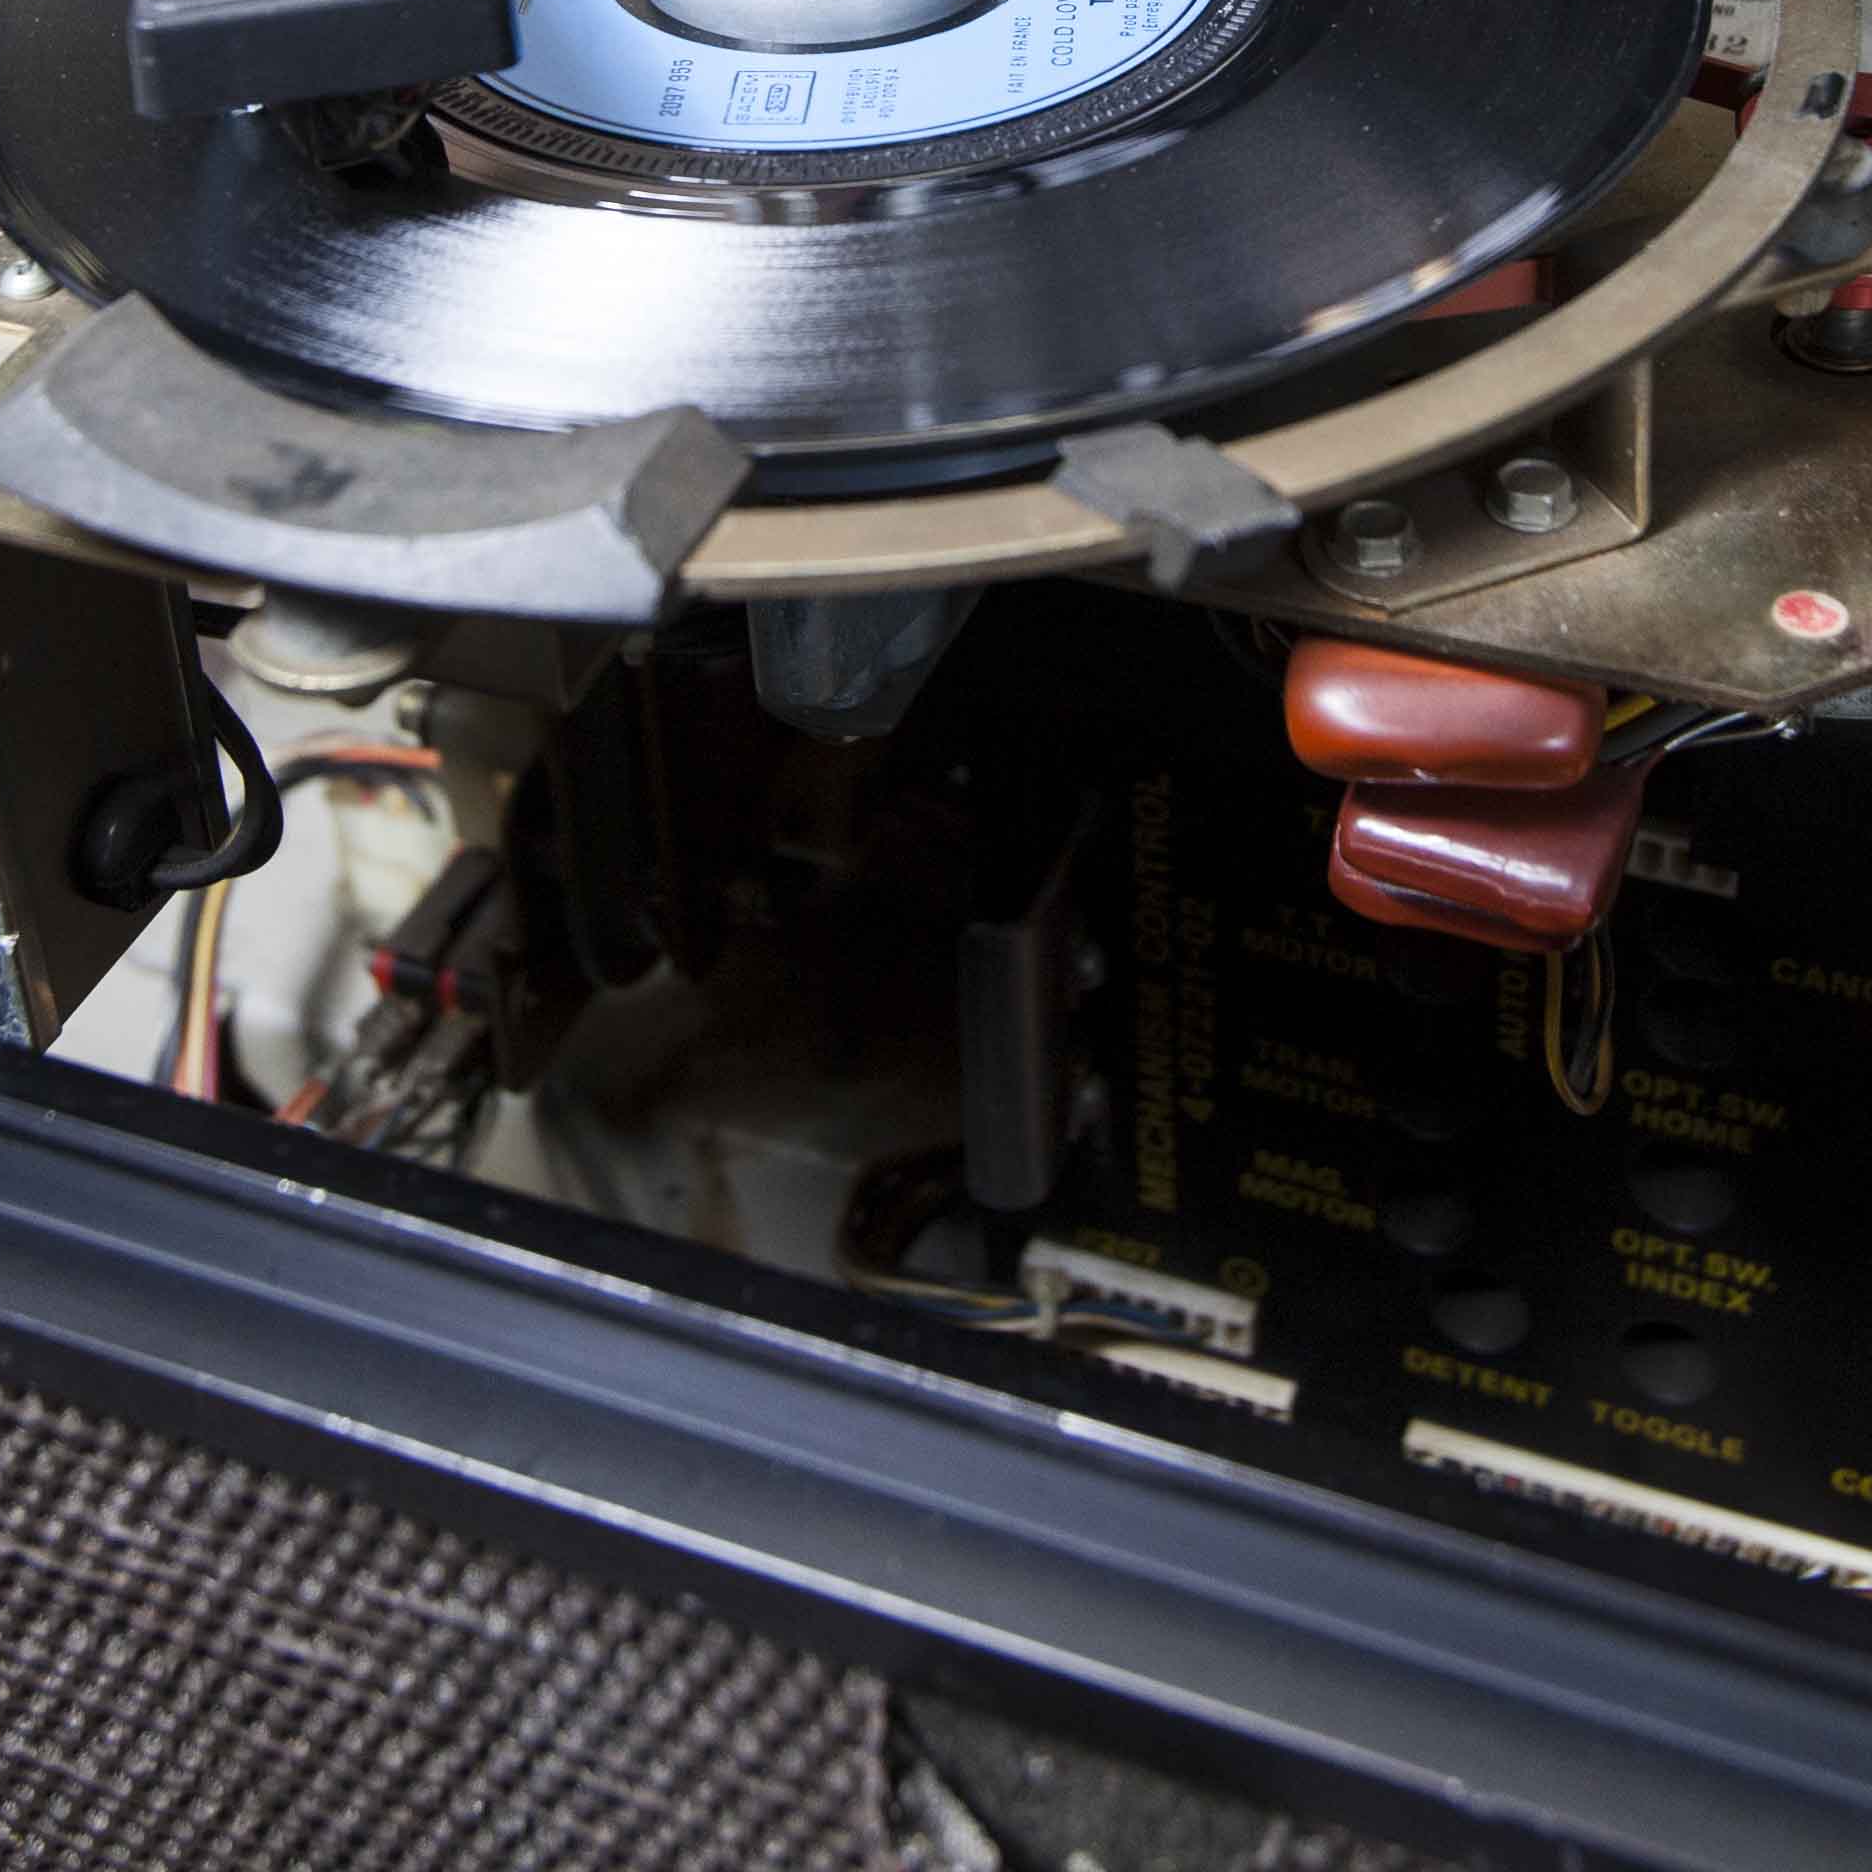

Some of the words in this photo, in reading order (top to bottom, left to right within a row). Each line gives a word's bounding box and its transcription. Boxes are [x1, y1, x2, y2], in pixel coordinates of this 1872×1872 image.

[1011, 14, 1032, 50] FRANCE
[1050, 24, 1074, 66] COLD
[667, 57, 694, 81] 955
[658, 85, 686, 116] 2097
[1132, 768, 1171, 962] CONTROL
[1133, 975, 1179, 1212] MECHANISM
[1630, 1100, 1755, 1155] HOME
[1237, 1170, 1378, 1232] MOTOR
[1624, 1260, 1753, 1316] INDEX
[1400, 1343, 1554, 1409] DETENT
[1588, 1395, 1746, 1466] TOGGLE
